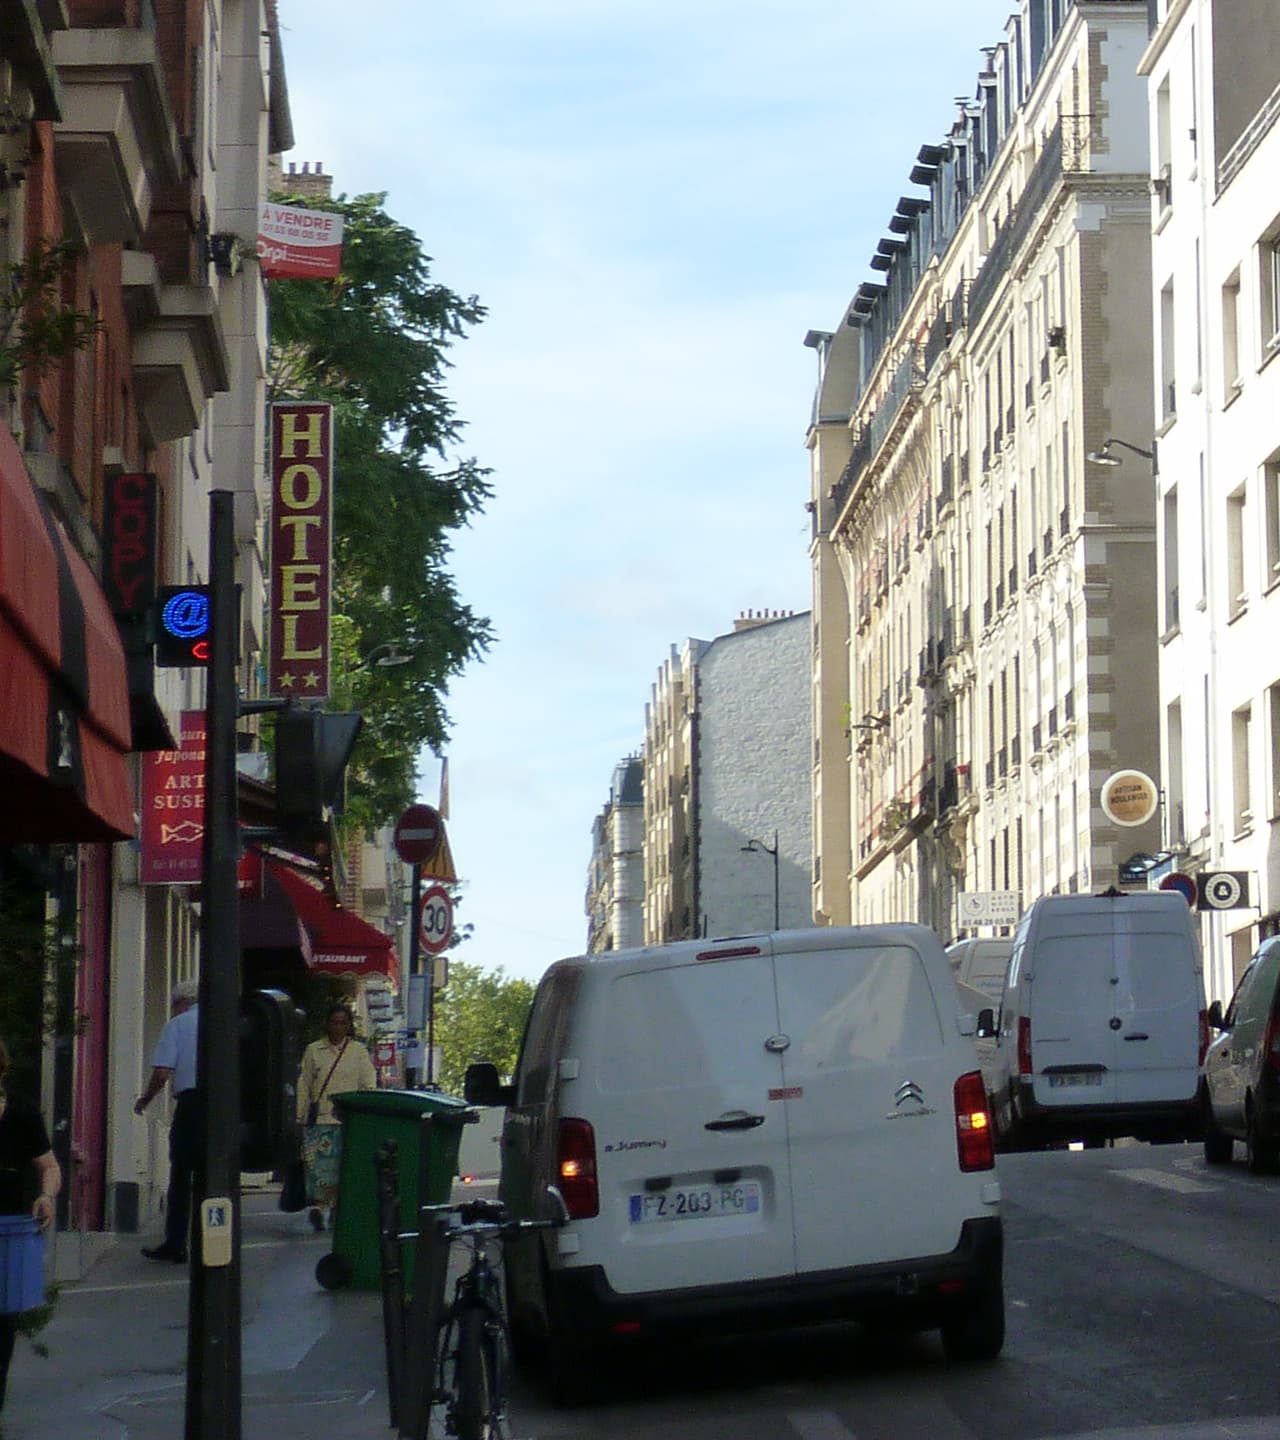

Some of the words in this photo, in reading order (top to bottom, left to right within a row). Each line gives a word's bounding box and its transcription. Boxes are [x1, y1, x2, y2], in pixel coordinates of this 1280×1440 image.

[275, 211, 334, 231] VENDRE
[112, 475, 148, 608] COPY
[279, 413, 323, 660] HOTEL
[154, 750, 206, 765] Japona
[424, 904, 448, 935] 30
[312, 954, 367, 964] STAURANT
